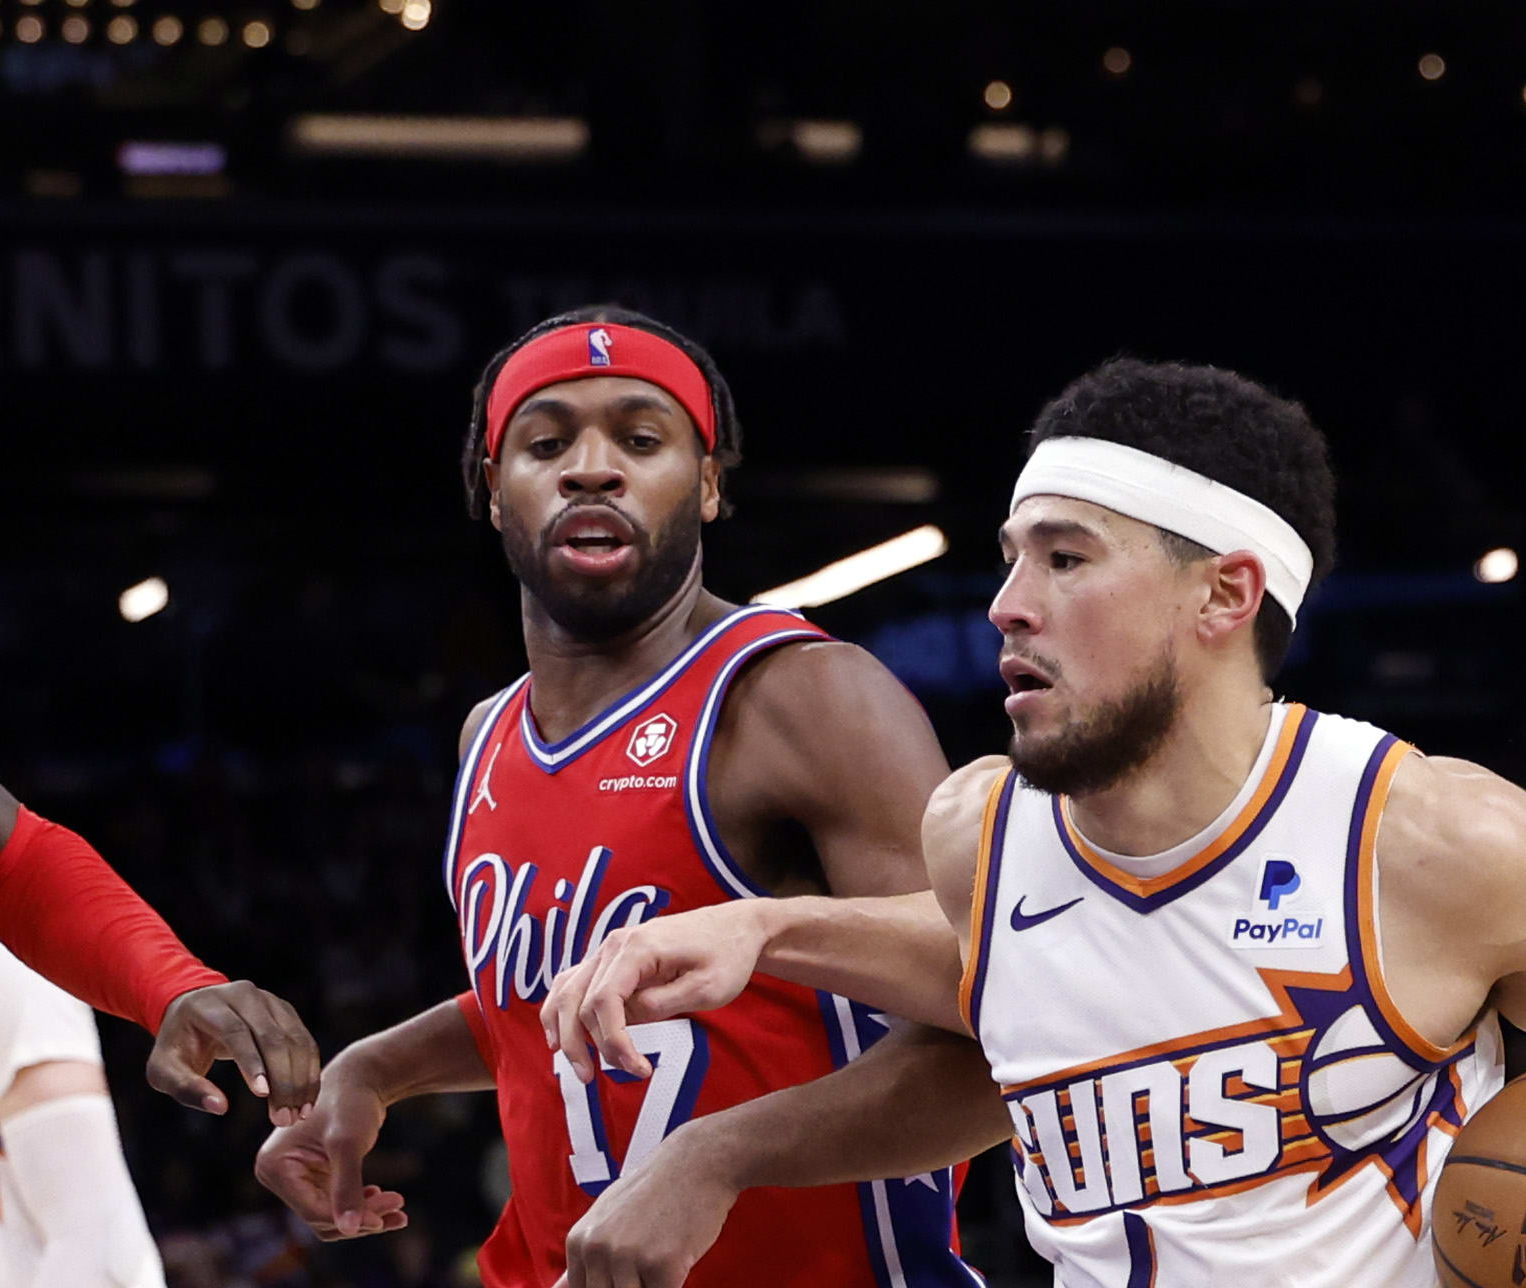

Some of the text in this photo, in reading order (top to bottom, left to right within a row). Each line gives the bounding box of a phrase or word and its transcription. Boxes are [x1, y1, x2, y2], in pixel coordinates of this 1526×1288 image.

[598, 774, 678, 793] crypto.com
[1233, 918, 1323, 943] PayPal
[553, 1018, 711, 1198] 17
